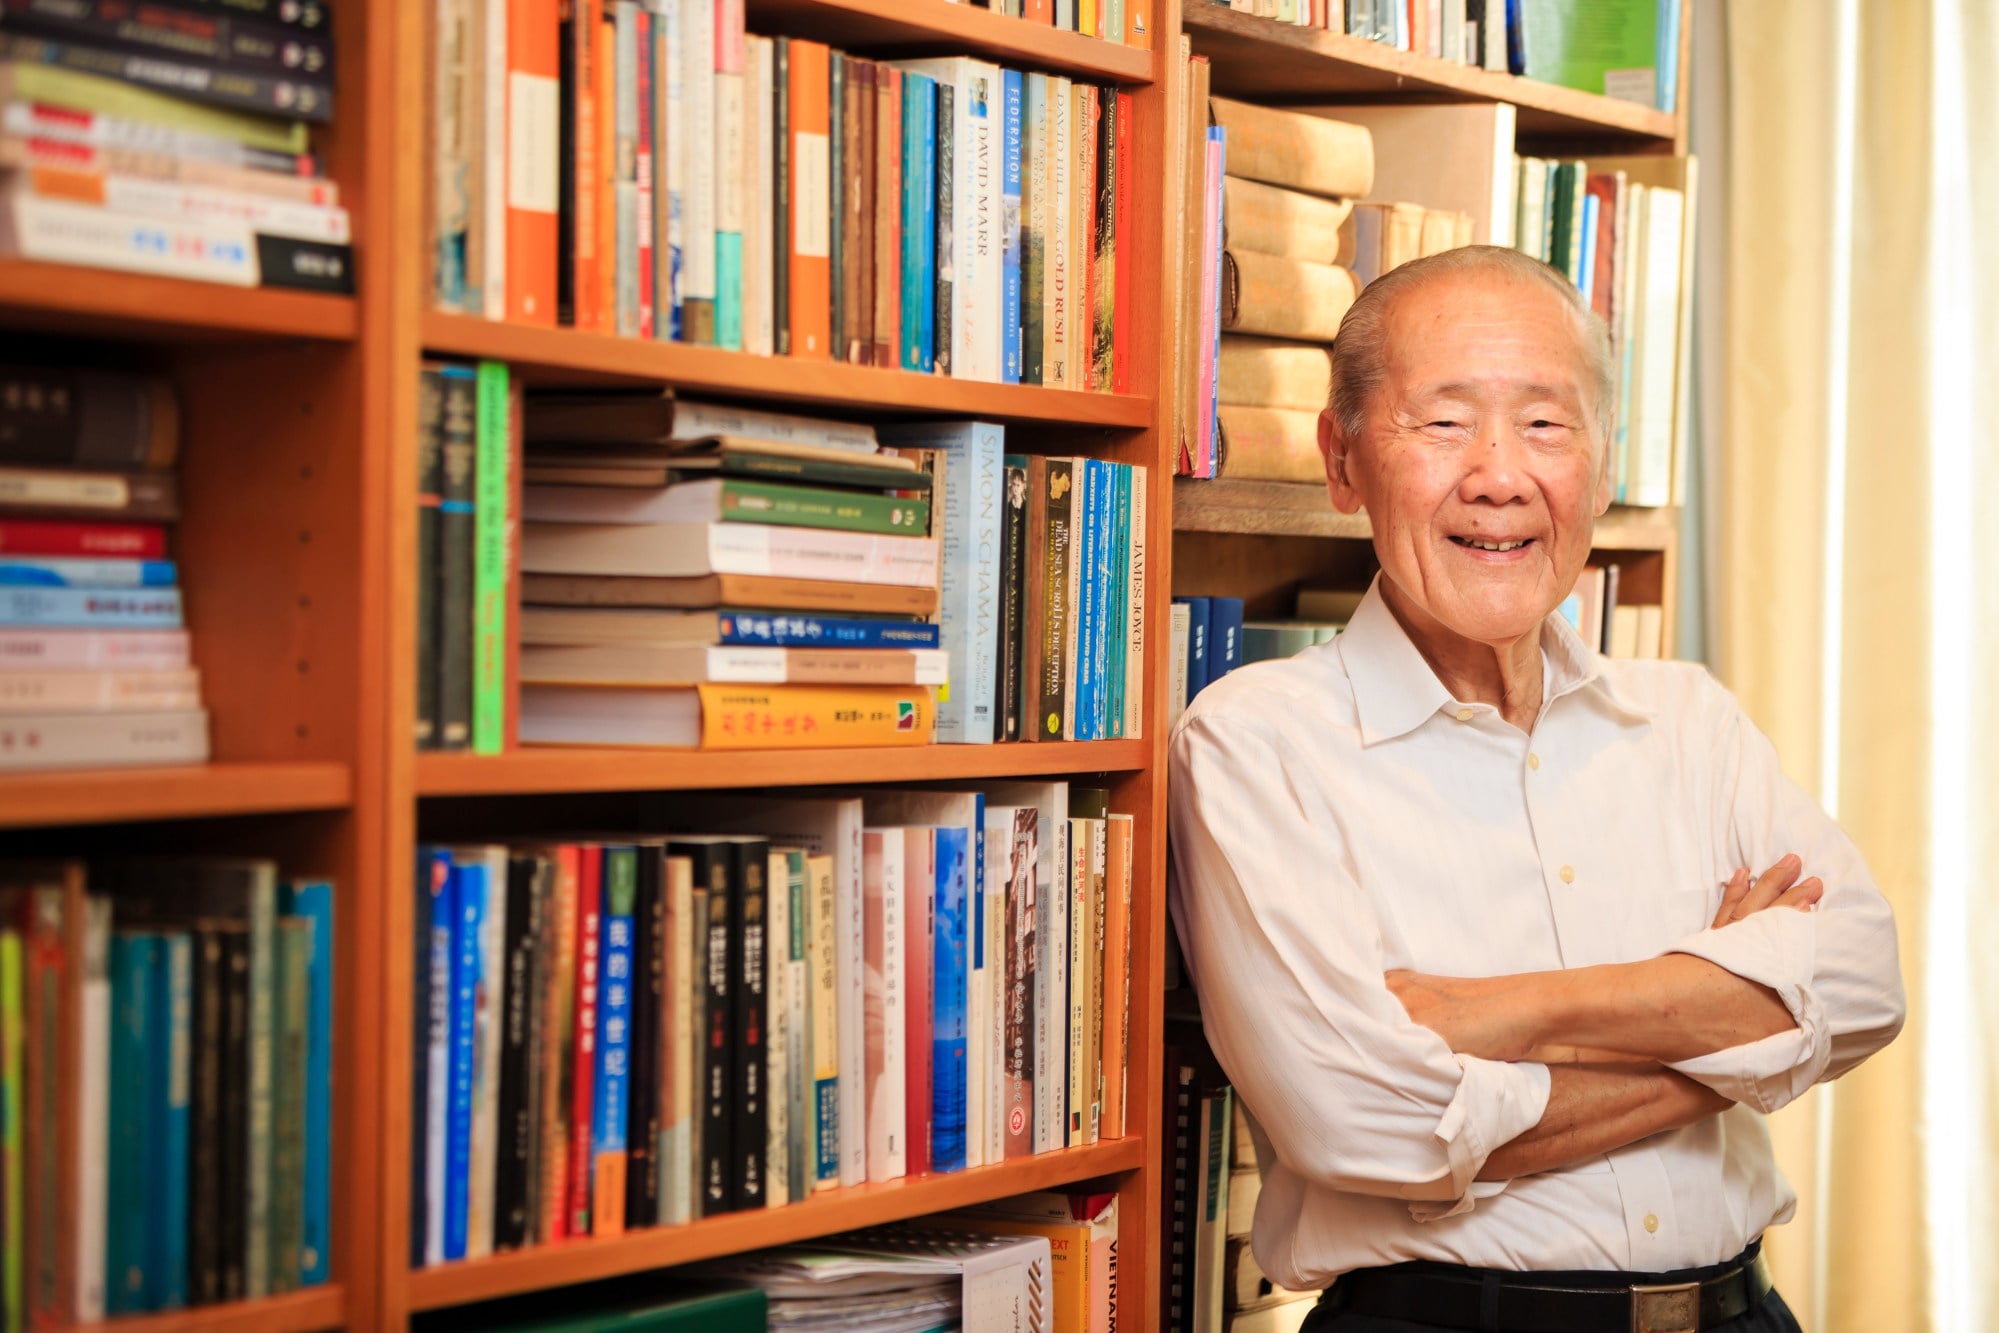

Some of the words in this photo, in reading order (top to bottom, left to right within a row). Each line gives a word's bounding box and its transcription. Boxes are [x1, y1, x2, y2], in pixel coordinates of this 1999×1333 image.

[1010, 88, 1019, 183] FEDERATION
[1056, 94, 1064, 152] DAVID
[978, 126, 988, 186] DAVID
[1056, 158, 1064, 197] HILL
[1079, 134, 1087, 172] Wright
[978, 195, 987, 256] MARR
[1055, 240, 1064, 291] GOLD
[1055, 298, 1064, 344] RUSH
[980, 434, 997, 519] SIMON
[1055, 521, 1063, 551] DEAD
[1088, 514, 1095, 526] ON
[1054, 554, 1062, 574] SEA
[1087, 529, 1095, 580] LITERATURE
[1134, 540, 1143, 598] JAMES
[976, 528, 993, 637] SCHAMA
[1053, 578, 1063, 629] SCROLLS
[1085, 615, 1091, 626] BY
[1132, 602, 1142, 652] JOYCE
[1051, 632, 1059, 695] DECEPTION
[1051, 1240, 1069, 1250] EXT
[1109, 1240, 1117, 1333] VIETNAM
